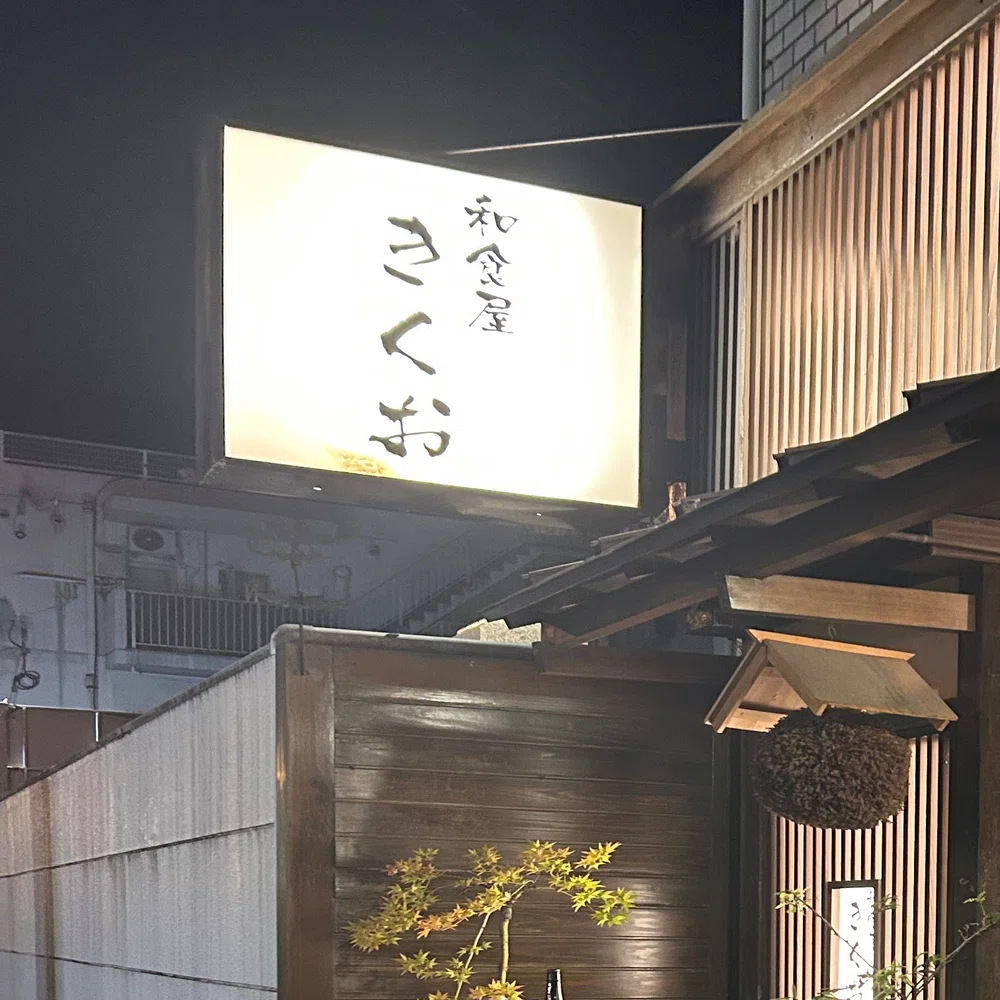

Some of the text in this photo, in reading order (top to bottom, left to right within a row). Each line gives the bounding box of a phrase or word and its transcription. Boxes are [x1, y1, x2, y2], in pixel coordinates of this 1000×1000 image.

[369, 216, 451, 458] きくお
[464, 194, 518, 333] 和食屋
